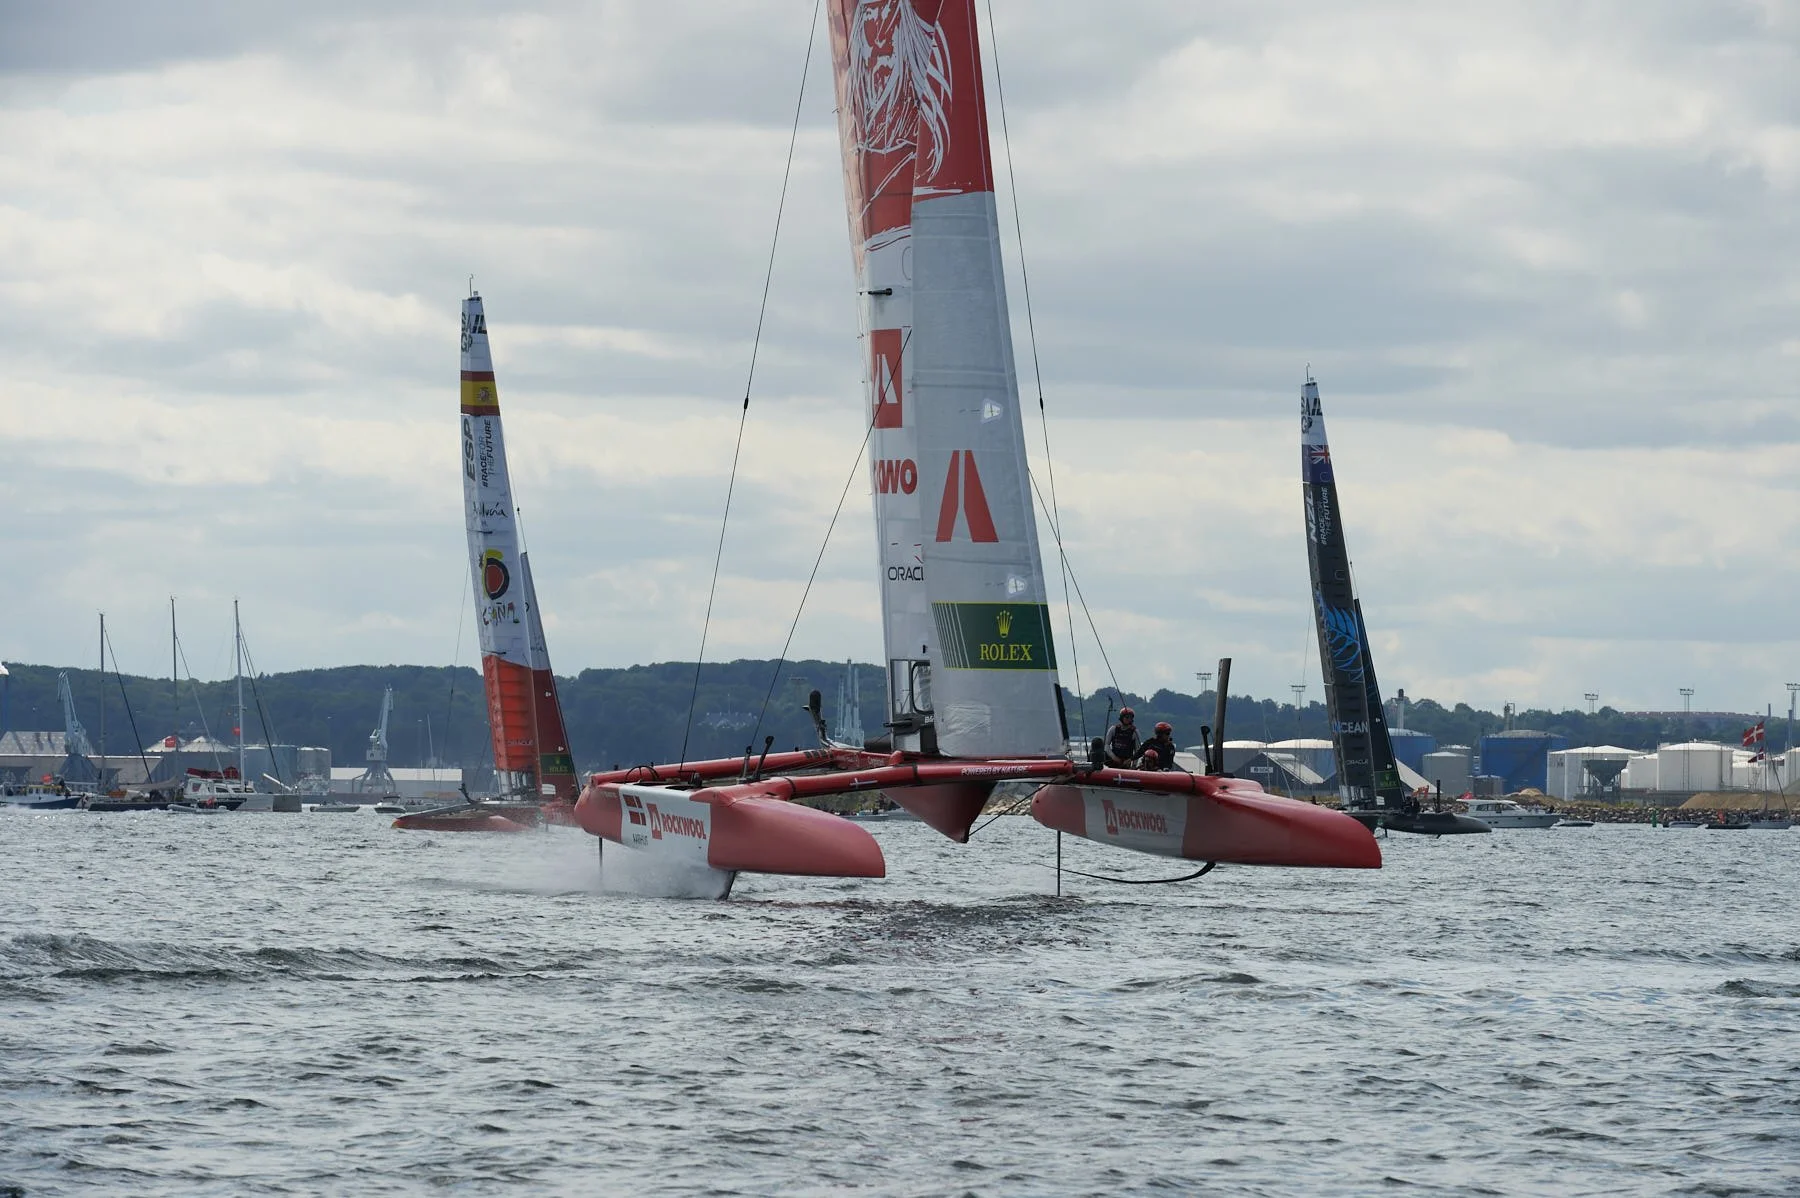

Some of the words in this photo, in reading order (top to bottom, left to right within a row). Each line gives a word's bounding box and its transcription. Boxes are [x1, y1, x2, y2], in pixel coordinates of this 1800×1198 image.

[463, 418, 476, 482] ESP
[483, 419, 495, 475] THEFUTURE
[1305, 490, 1318, 543] NZL
[979, 643, 1033, 661] ROLEX
[961, 767, 991, 776] POWERED
[660, 812, 707, 840] ROCKWOOL
[1117, 809, 1168, 834] ROCKWOOL
